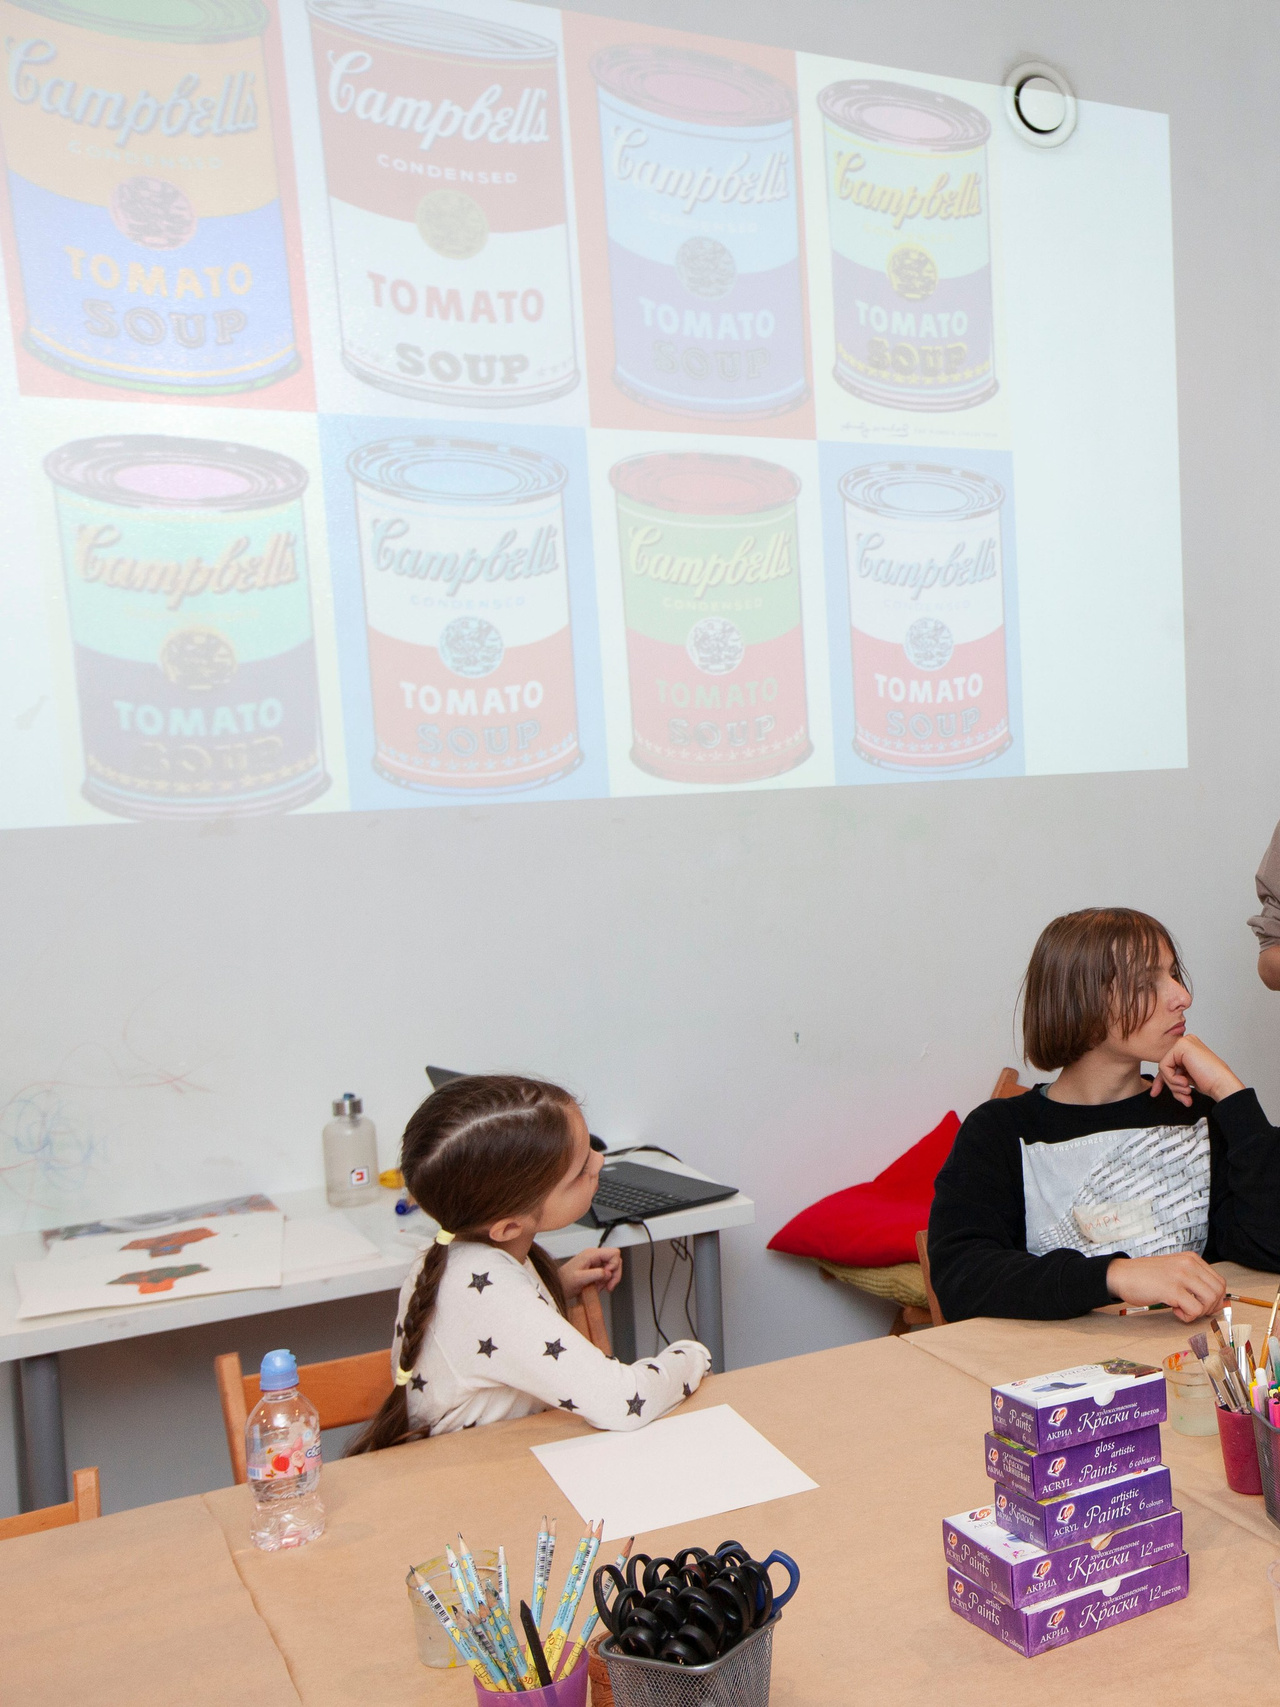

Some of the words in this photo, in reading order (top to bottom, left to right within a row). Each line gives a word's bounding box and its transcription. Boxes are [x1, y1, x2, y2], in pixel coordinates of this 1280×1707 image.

[327, 49, 549, 150] Campbell's
[376, 153, 518, 184] CONDENSED
[64, 246, 253, 299] TOMATO
[366, 270, 544, 323] TOMATO
[82, 298, 248, 349] SOUP
[639, 296, 776, 340] TOMATO
[855, 300, 969, 338] TOMATO
[396, 342, 529, 386] SOUP
[652, 339, 771, 382] SOUP
[867, 336, 968, 378] SOUP
[371, 518, 559, 597] Campbell's
[628, 525, 792, 600] Campbell's
[856, 532, 998, 601] Campbell's
[410, 595, 527, 610] CONDENSED
[662, 597, 764, 612] CONDENSED
[400, 680, 544, 716] TOMATO
[655, 676, 778, 710] TOMATO
[874, 672, 984, 704] TOMATO
[113, 697, 285, 737] TOMATO
[668, 714, 776, 750] SOUP
[886, 706, 980, 740] SOUP
[416, 720, 541, 757] SOUP
[1053, 1137, 1103, 1152] PRZYMORZE
[1008, 1409, 1032, 1433] Paints
[1047, 1428, 1073, 1441] АКРИЛ
[1077, 1410, 1129, 1436] Краски
[1133, 1407, 1141, 1419] 6
[1140, 1408, 1160, 1417] цветов
[1094, 1441, 1115, 1458] gloss
[1110, 1445, 1136, 1458] artistic
[1078, 1461, 1118, 1483] Paints
[1128, 1460, 1134, 1468] 6
[1134, 1455, 1157, 1467] colours
[1041, 1478, 1073, 1494] ACRYL
[1110, 1488, 1140, 1505] artistic
[1008, 1502, 1035, 1527] Краски
[1083, 1501, 1131, 1528] Paints
[1138, 1498, 1146, 1510] 6
[1145, 1498, 1164, 1509] colours
[1053, 1523, 1079, 1537] ACRYL
[961, 1543, 990, 1578] Paints
[977, 1550, 991, 1564] artistic
[1067, 1550, 1130, 1583] Краски
[1140, 1541, 1154, 1559] 12
[1153, 1541, 1175, 1554] цветов
[1090, 1540, 1140, 1561] художественные
[990, 1581, 998, 1594] 12
[1026, 1578, 1057, 1595] АКРИЛ
[1101, 1584, 1149, 1608] художественные
[968, 1592, 1001, 1626] Paints
[985, 1598, 1002, 1612] artistic
[1079, 1596, 1138, 1630] Краски
[1149, 1585, 1162, 1603] 12
[1161, 1585, 1182, 1598] цветов
[1001, 1629, 1009, 1642] 12
[1039, 1627, 1070, 1644] АКРИЛ
